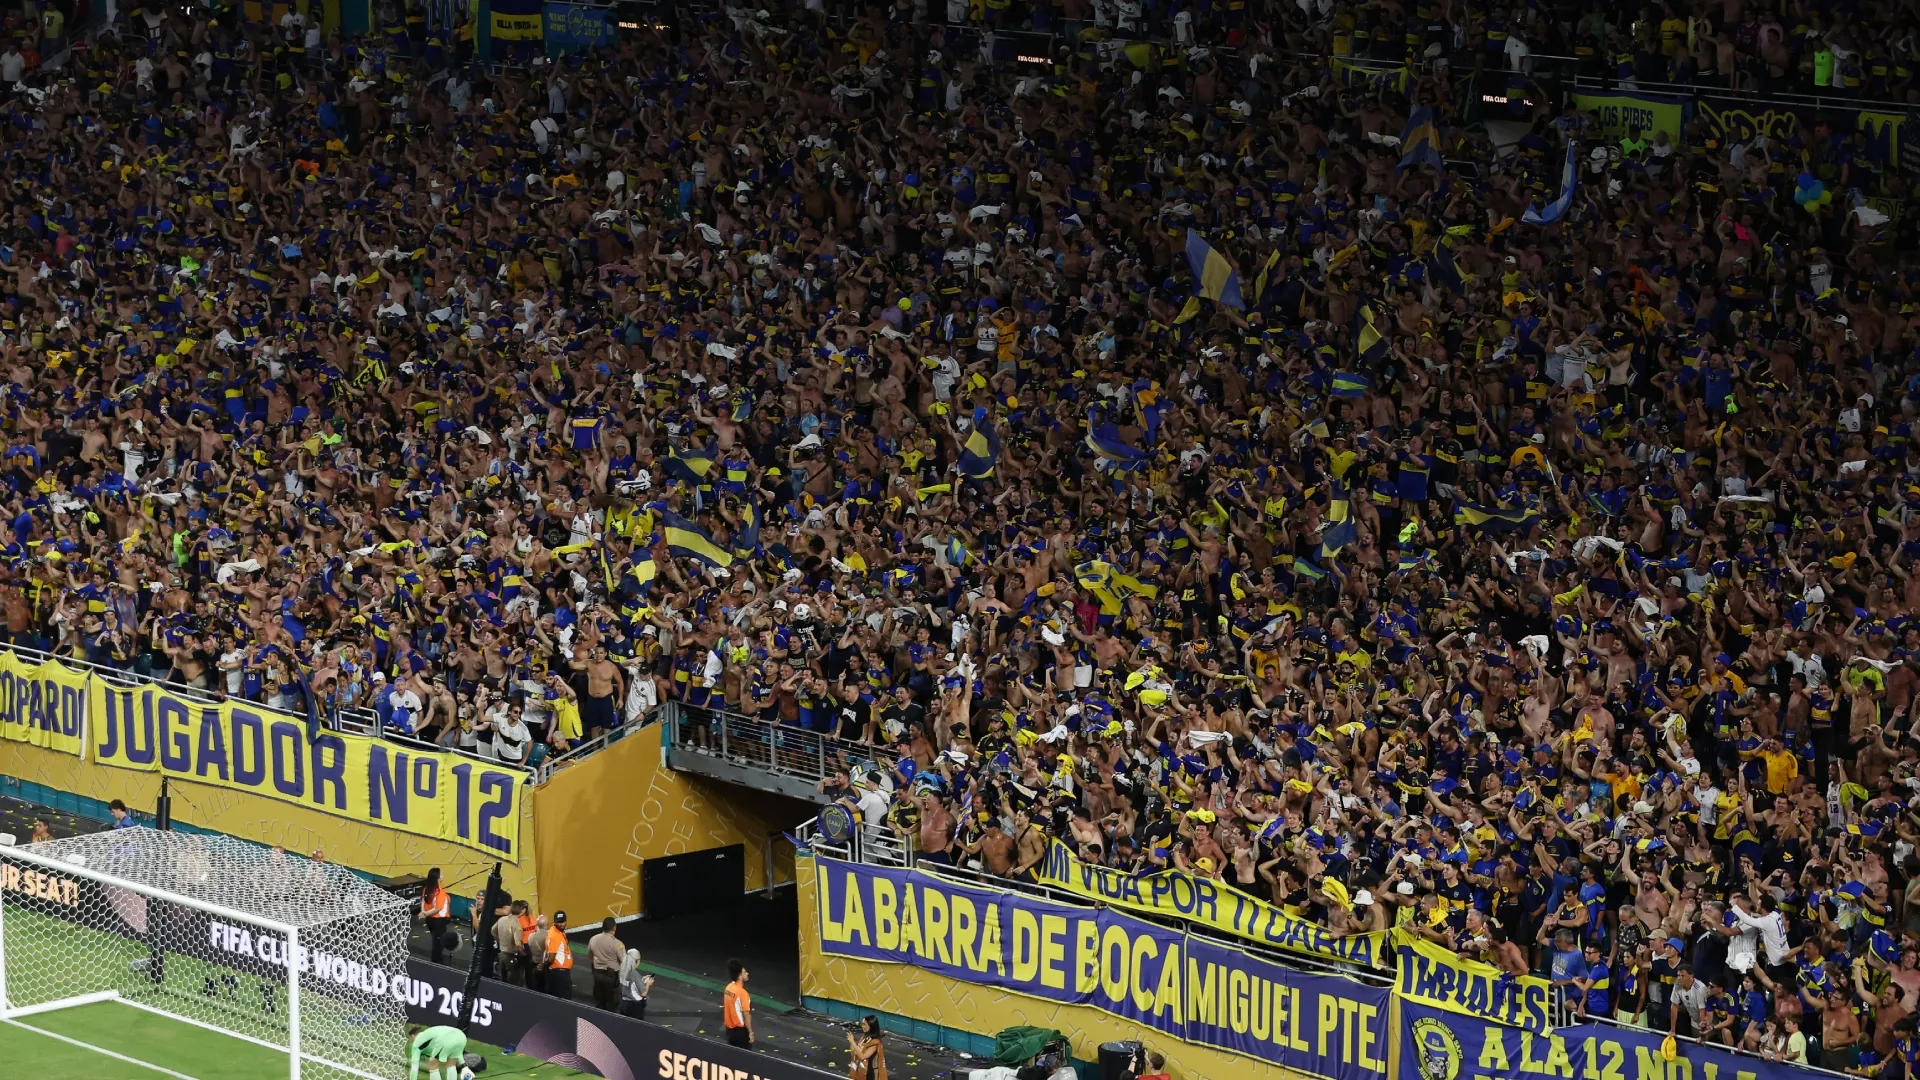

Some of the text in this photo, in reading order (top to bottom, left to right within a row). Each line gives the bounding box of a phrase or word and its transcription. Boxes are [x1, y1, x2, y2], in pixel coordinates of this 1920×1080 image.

[1482, 94, 1494, 103] FIFA
[1494, 95, 1508, 104] CLUB
[1621, 106, 1653, 132] PIBES
[1181, 588, 1196, 602] 12
[0, 668, 85, 740] OPARDI
[98, 687, 348, 810] JUGADOR
[454, 763, 514, 855] 12
[24, 870, 79, 907] SEAT!
[1042, 837, 1070, 885] MI
[1081, 864, 1145, 905] VIDA
[1152, 872, 1218, 922] POR
[1224, 888, 1260, 936] TI
[212, 921, 255, 958] FIFA
[258, 934, 308, 973] CLUB
[313, 950, 388, 996] WORLD
[391, 974, 434, 1010] CUP
[820, 865, 871, 947] LA
[873, 876, 1006, 978] BARRA
[1012, 908, 1067, 990] DE
[1075, 918, 1185, 1027] BOCA
[1187, 956, 1310, 1053] MIGUEL
[1478, 1026, 1510, 1071] A
[1519, 1030, 1575, 1078] LA
[1583, 1036, 1625, 1080] 12
